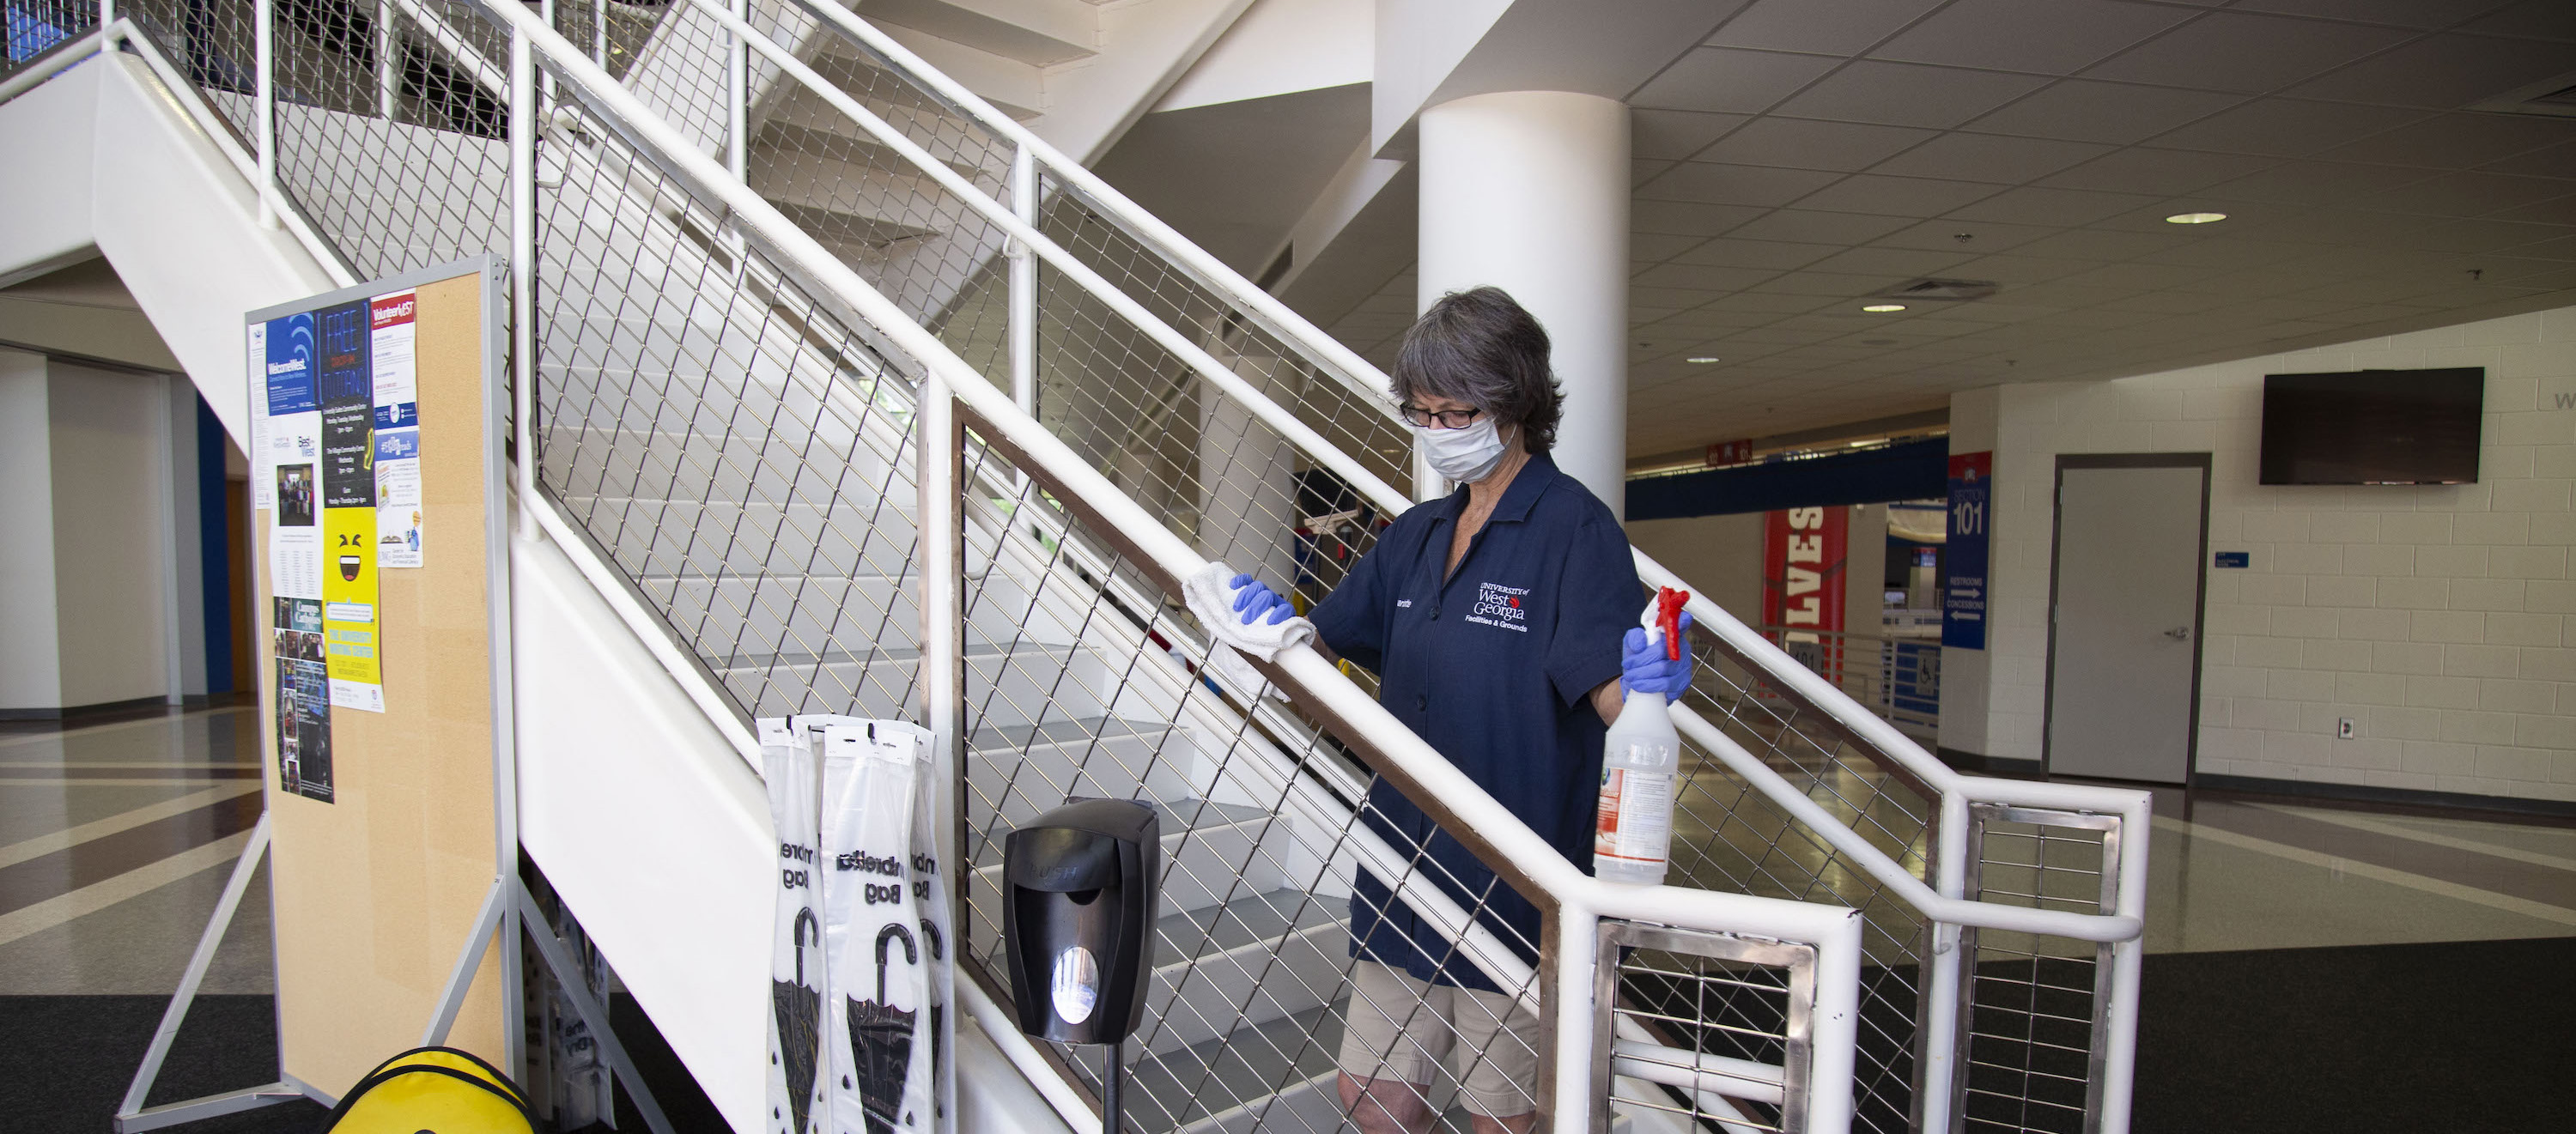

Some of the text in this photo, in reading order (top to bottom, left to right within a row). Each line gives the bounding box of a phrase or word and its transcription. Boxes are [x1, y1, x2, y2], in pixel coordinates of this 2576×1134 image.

[326, 309, 357, 355] FREE
[1953, 501, 1983, 535] 101
[1480, 582, 1530, 597] UNIVERSITY of
[1950, 576, 1983, 586] RESTROOMS
[1479, 589, 1510, 606] West
[1947, 599, 1984, 610] CONCESSIONS
[1473, 601, 1525, 621] Georgia
[1465, 614, 1492, 626] Facilities
[1499, 621, 1528, 633] Grounds
